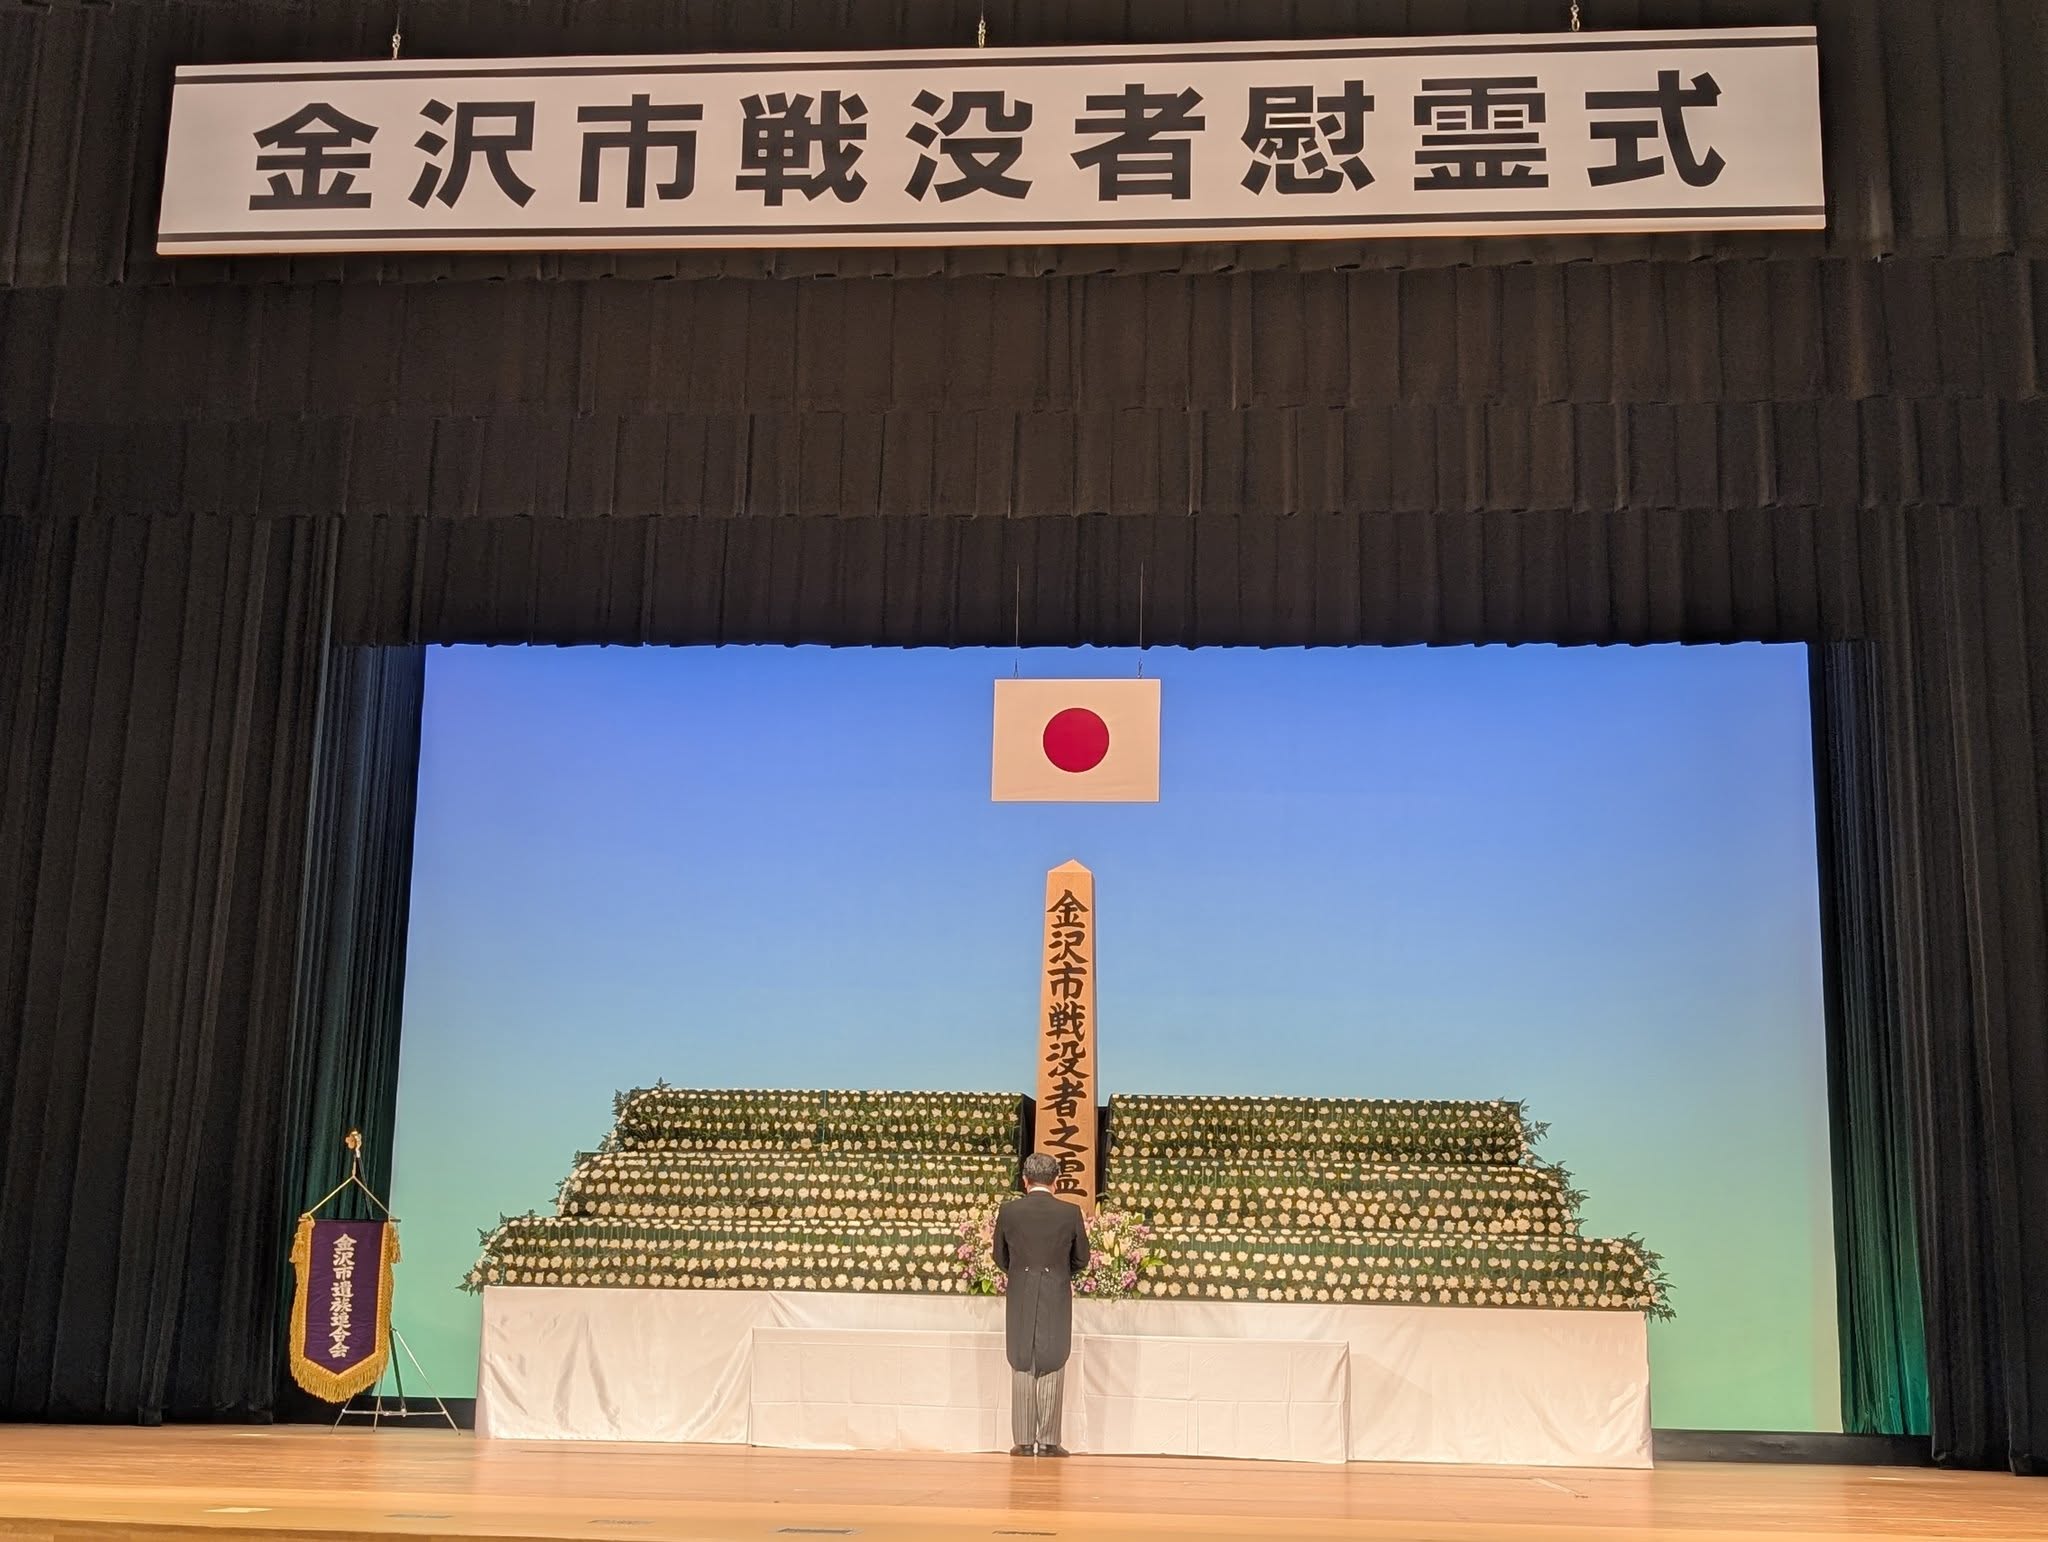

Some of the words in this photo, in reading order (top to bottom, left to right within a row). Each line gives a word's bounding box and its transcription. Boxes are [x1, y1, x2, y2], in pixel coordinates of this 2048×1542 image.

[248, 69, 1725, 210] 金沢市戦没者慰霊式
[329, 1233, 357, 1358] 金沢市遺族連合会
